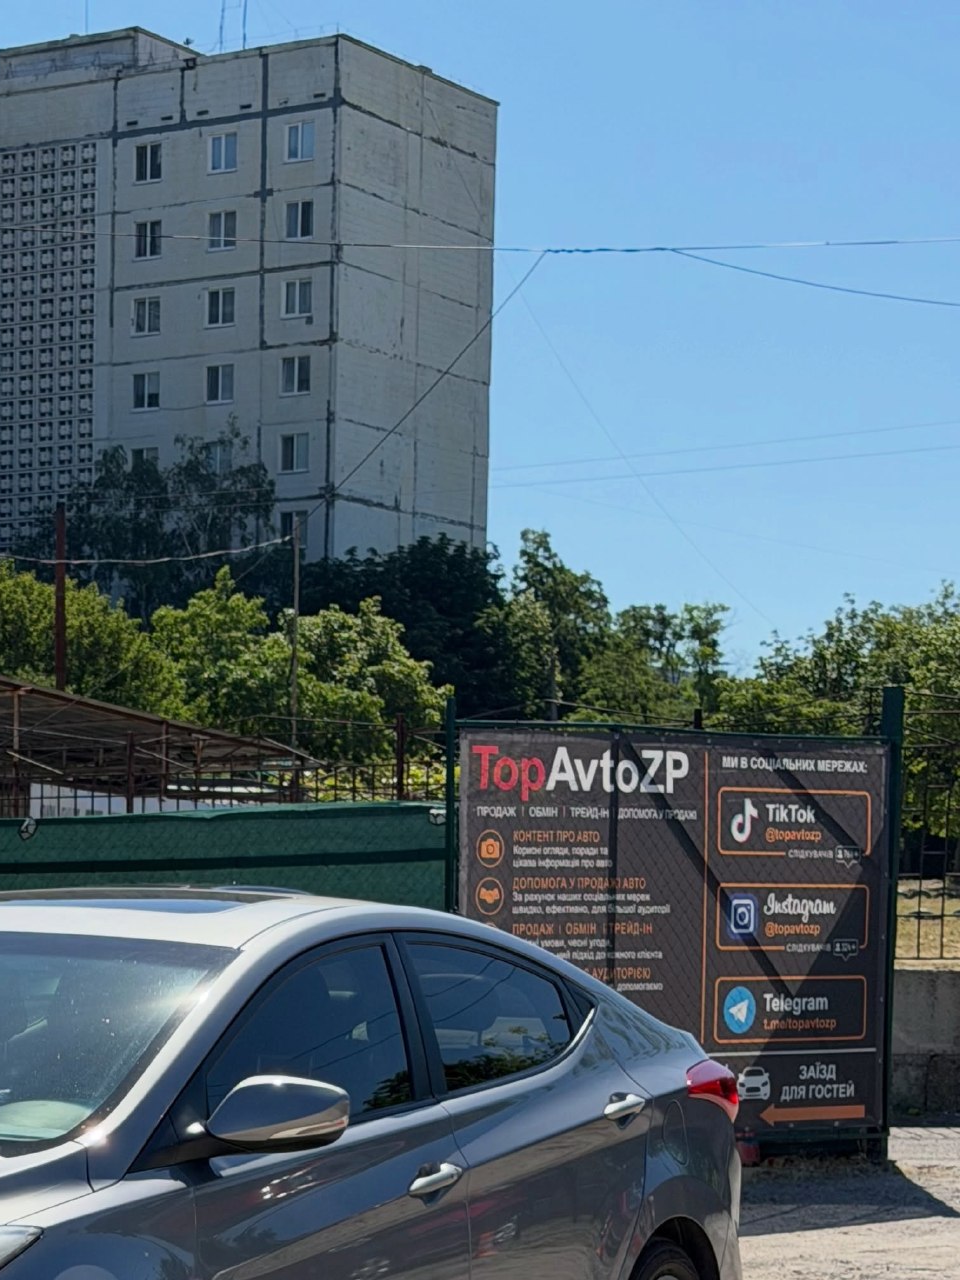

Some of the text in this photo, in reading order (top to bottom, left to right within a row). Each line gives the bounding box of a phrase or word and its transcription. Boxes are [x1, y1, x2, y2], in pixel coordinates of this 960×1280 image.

[721, 756, 869, 774] МИ В СОЦІАЛЬНИХ МЕРЕЖАХ:
[476, 806, 517, 819] ПРОДАЖ
[529, 806, 559, 818] ОБМІН
[617, 807, 658, 821] ДОПОМОГА
[765, 802, 816, 824] TikTok
[513, 830, 600, 843] КОНТЕНТ ПРО АВТО
[765, 827, 822, 843] @topavtozp
[512, 877, 567, 891] ДОПОМОГА
[568, 877, 575, 889] У
[623, 877, 647, 889] АВТО
[763, 893, 837, 924] Instagram
[512, 922, 554, 936] ПРОДАЖ
[565, 923, 597, 936] ОБМІН
[765, 921, 821, 937] @topavtozp
[763, 993, 829, 1016] Telegram
[763, 1017, 837, 1032] t.me/topavtozp
[799, 1061, 836, 1081] ЗАЇЗД
[780, 1080, 855, 1103] ДЛЯ ГОСТЕЙ
